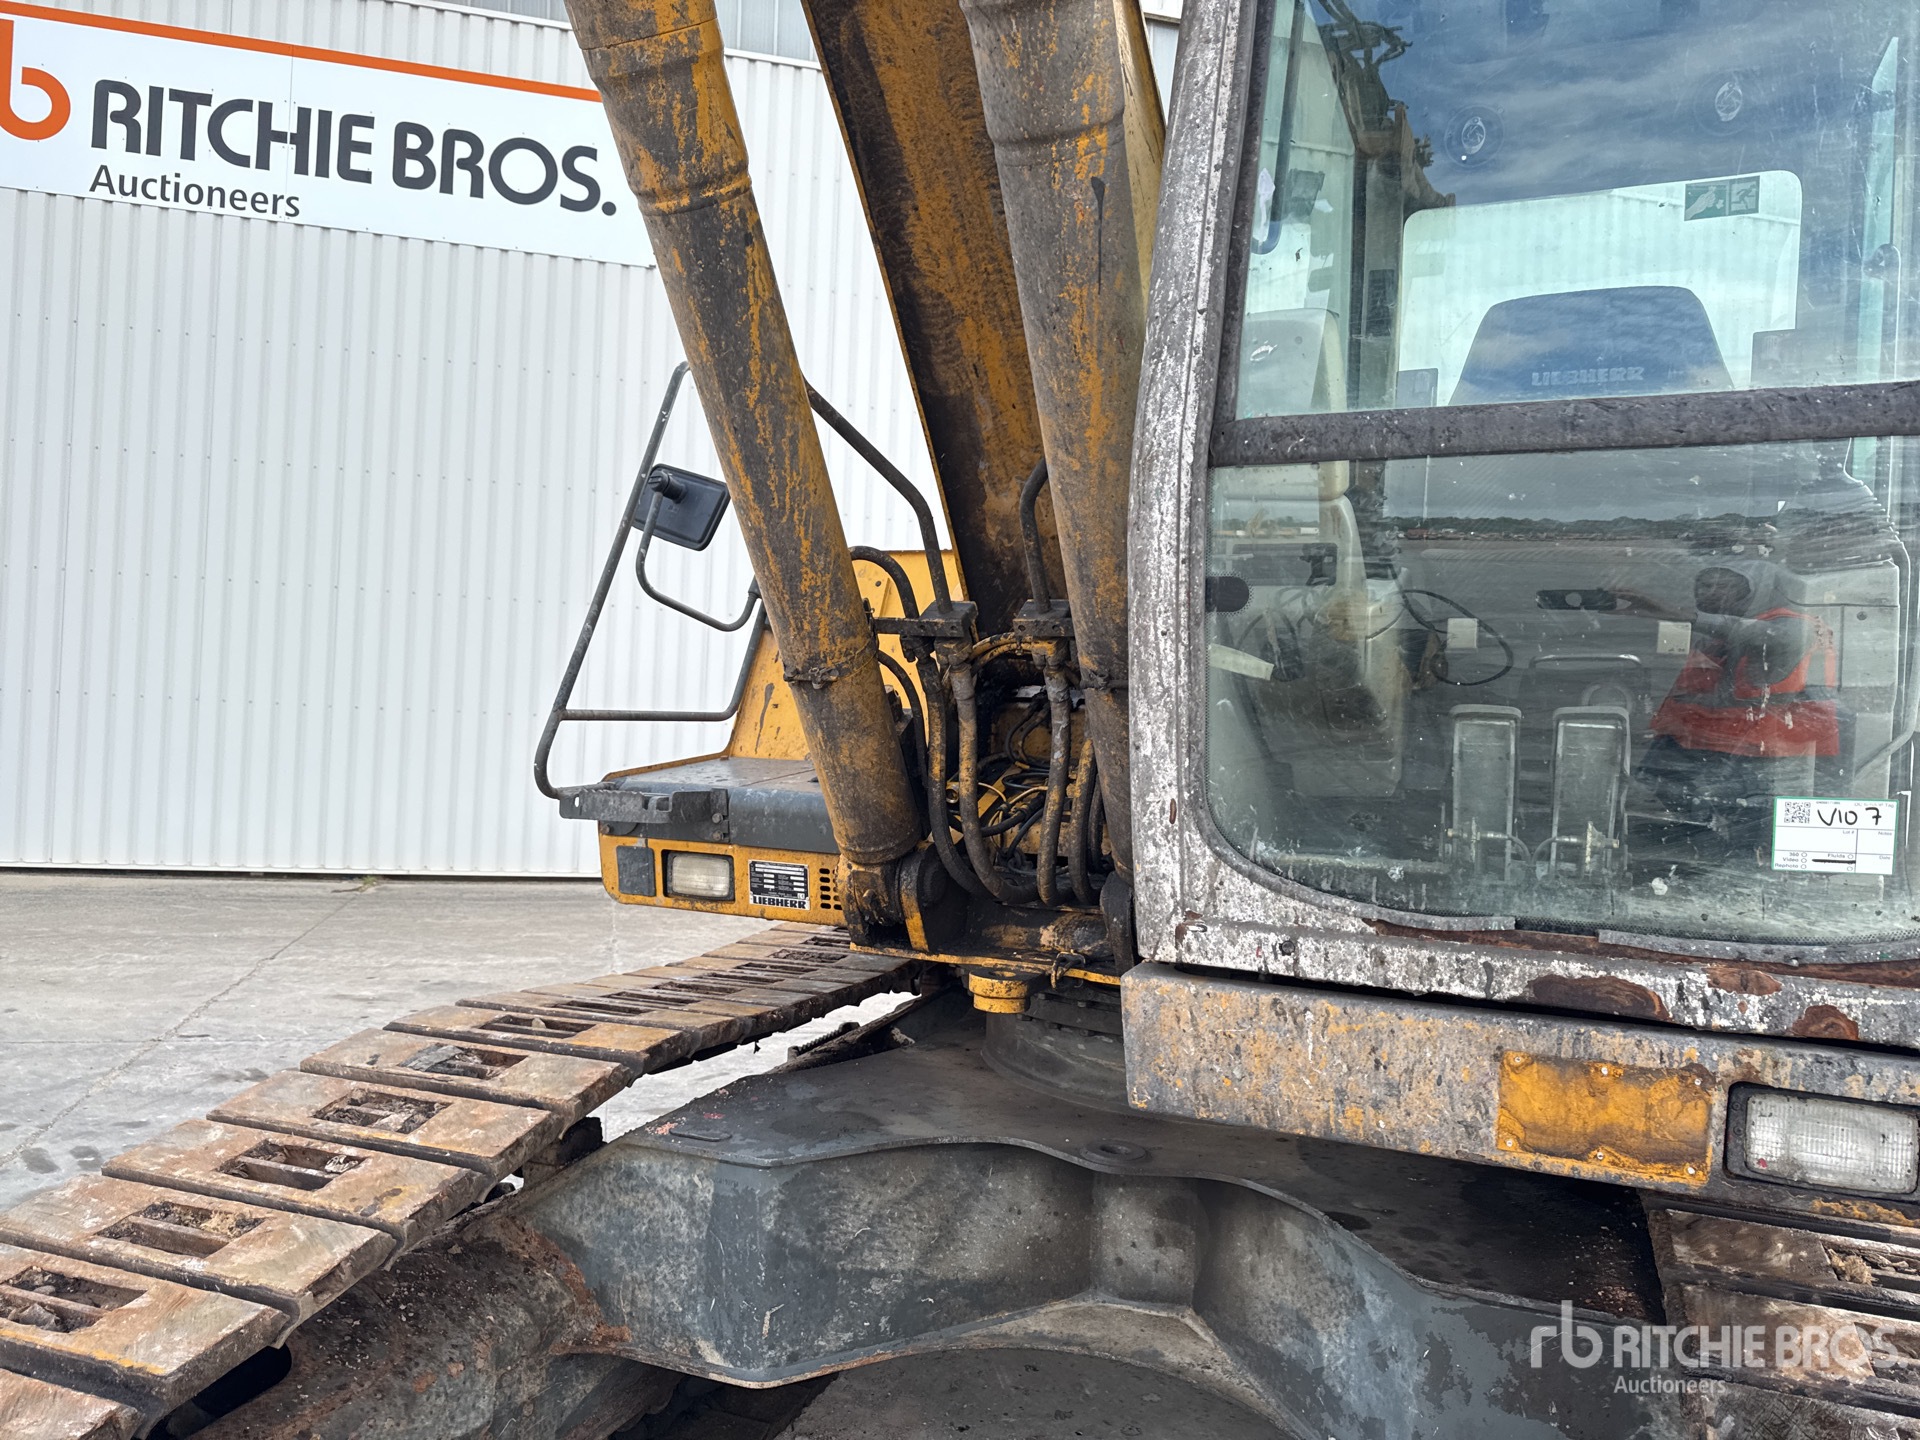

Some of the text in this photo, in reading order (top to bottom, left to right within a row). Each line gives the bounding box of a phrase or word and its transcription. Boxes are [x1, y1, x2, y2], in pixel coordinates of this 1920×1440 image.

[91, 79, 617, 216] RITCHIE BROS.
[89, 164, 300, 218] Auctioneers
[1531, 367, 1645, 386] LIEBHERR
[753, 896, 806, 909] LIEBHERR
